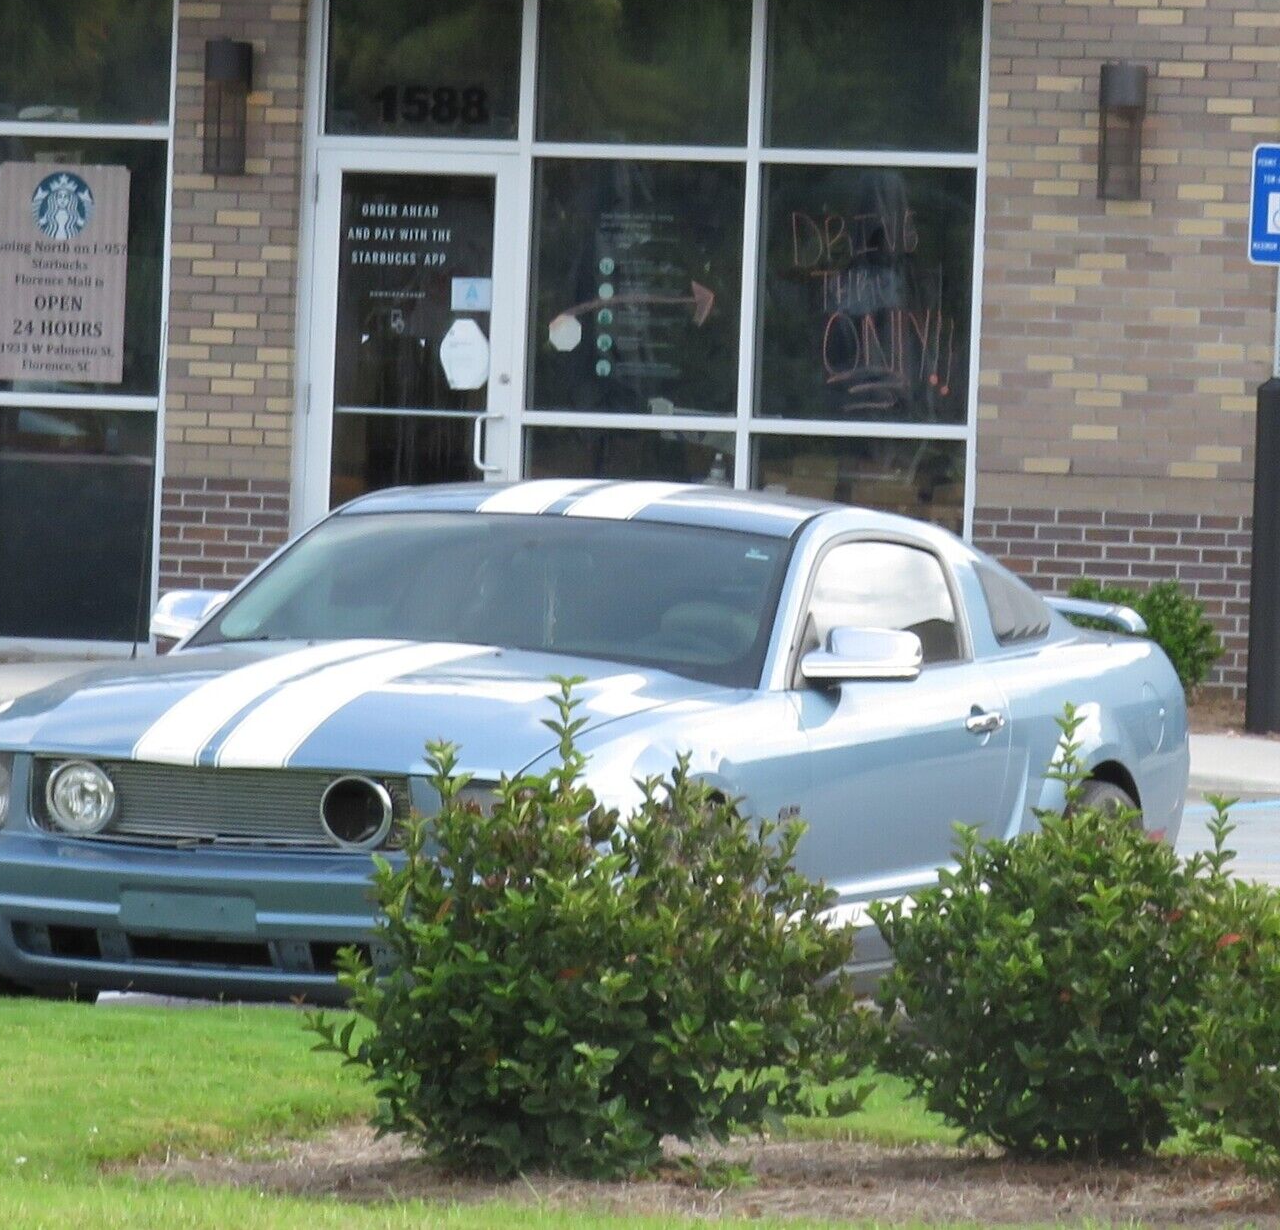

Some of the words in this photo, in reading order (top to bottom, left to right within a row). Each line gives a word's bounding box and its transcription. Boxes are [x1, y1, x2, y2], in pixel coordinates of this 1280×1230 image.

[376, 84, 489, 124] 1588
[362, 202, 398, 218] ORDER
[401, 203, 439, 219] AHEAD
[347, 226, 370, 241] AND
[374, 227, 395, 242] PAY
[400, 228, 428, 242] WITH
[432, 229, 452, 243] THE
[34, 240, 70, 254] North
[73, 244, 90, 255] on
[31, 258, 89, 270] Starbucks
[423, 252, 446, 266] APP
[14, 273, 64, 287] Florence
[67, 275, 92, 287] Mall
[95, 276, 104, 288] is
[33, 295, 83, 312] OPEN
[12, 319, 34, 336] 24
[40, 319, 103, 338] HOURS
[32, 343, 43, 355] W
